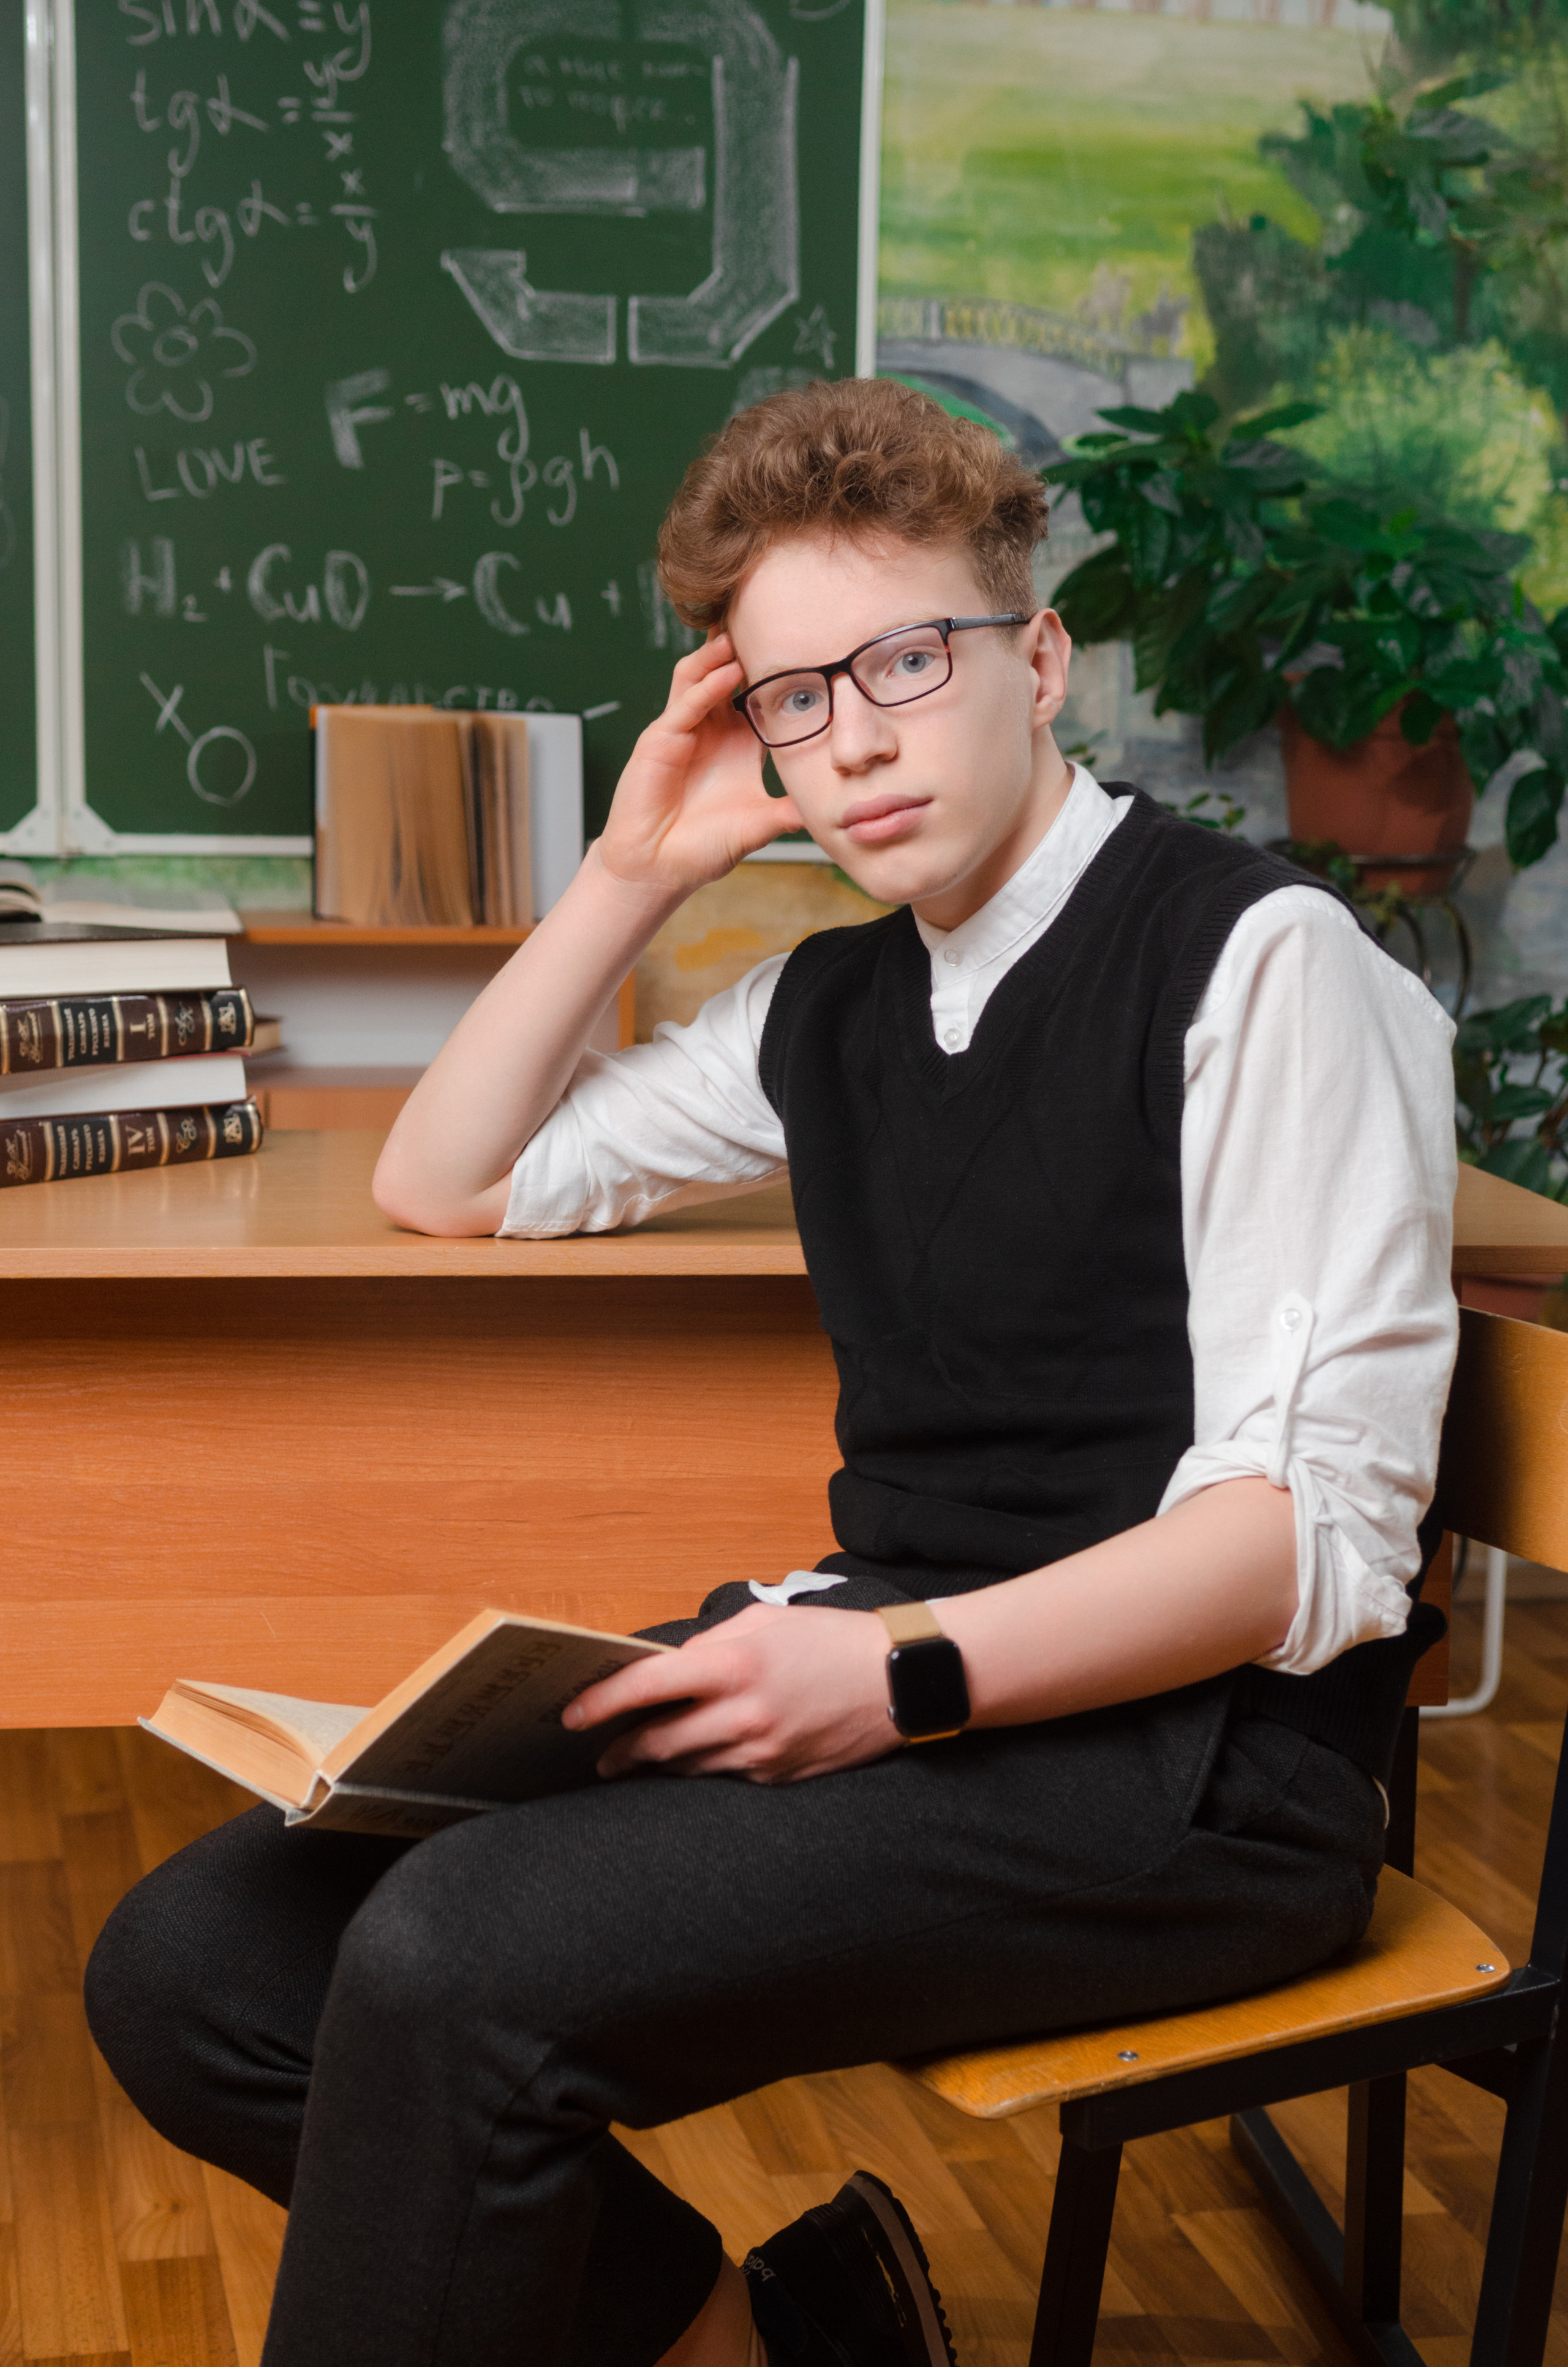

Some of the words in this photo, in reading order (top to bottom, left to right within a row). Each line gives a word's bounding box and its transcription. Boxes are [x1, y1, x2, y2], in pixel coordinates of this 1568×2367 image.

[135, 437, 288, 502] LOVE
[130, 1021, 146, 1034] I
[127, 1126, 146, 1155] IV
